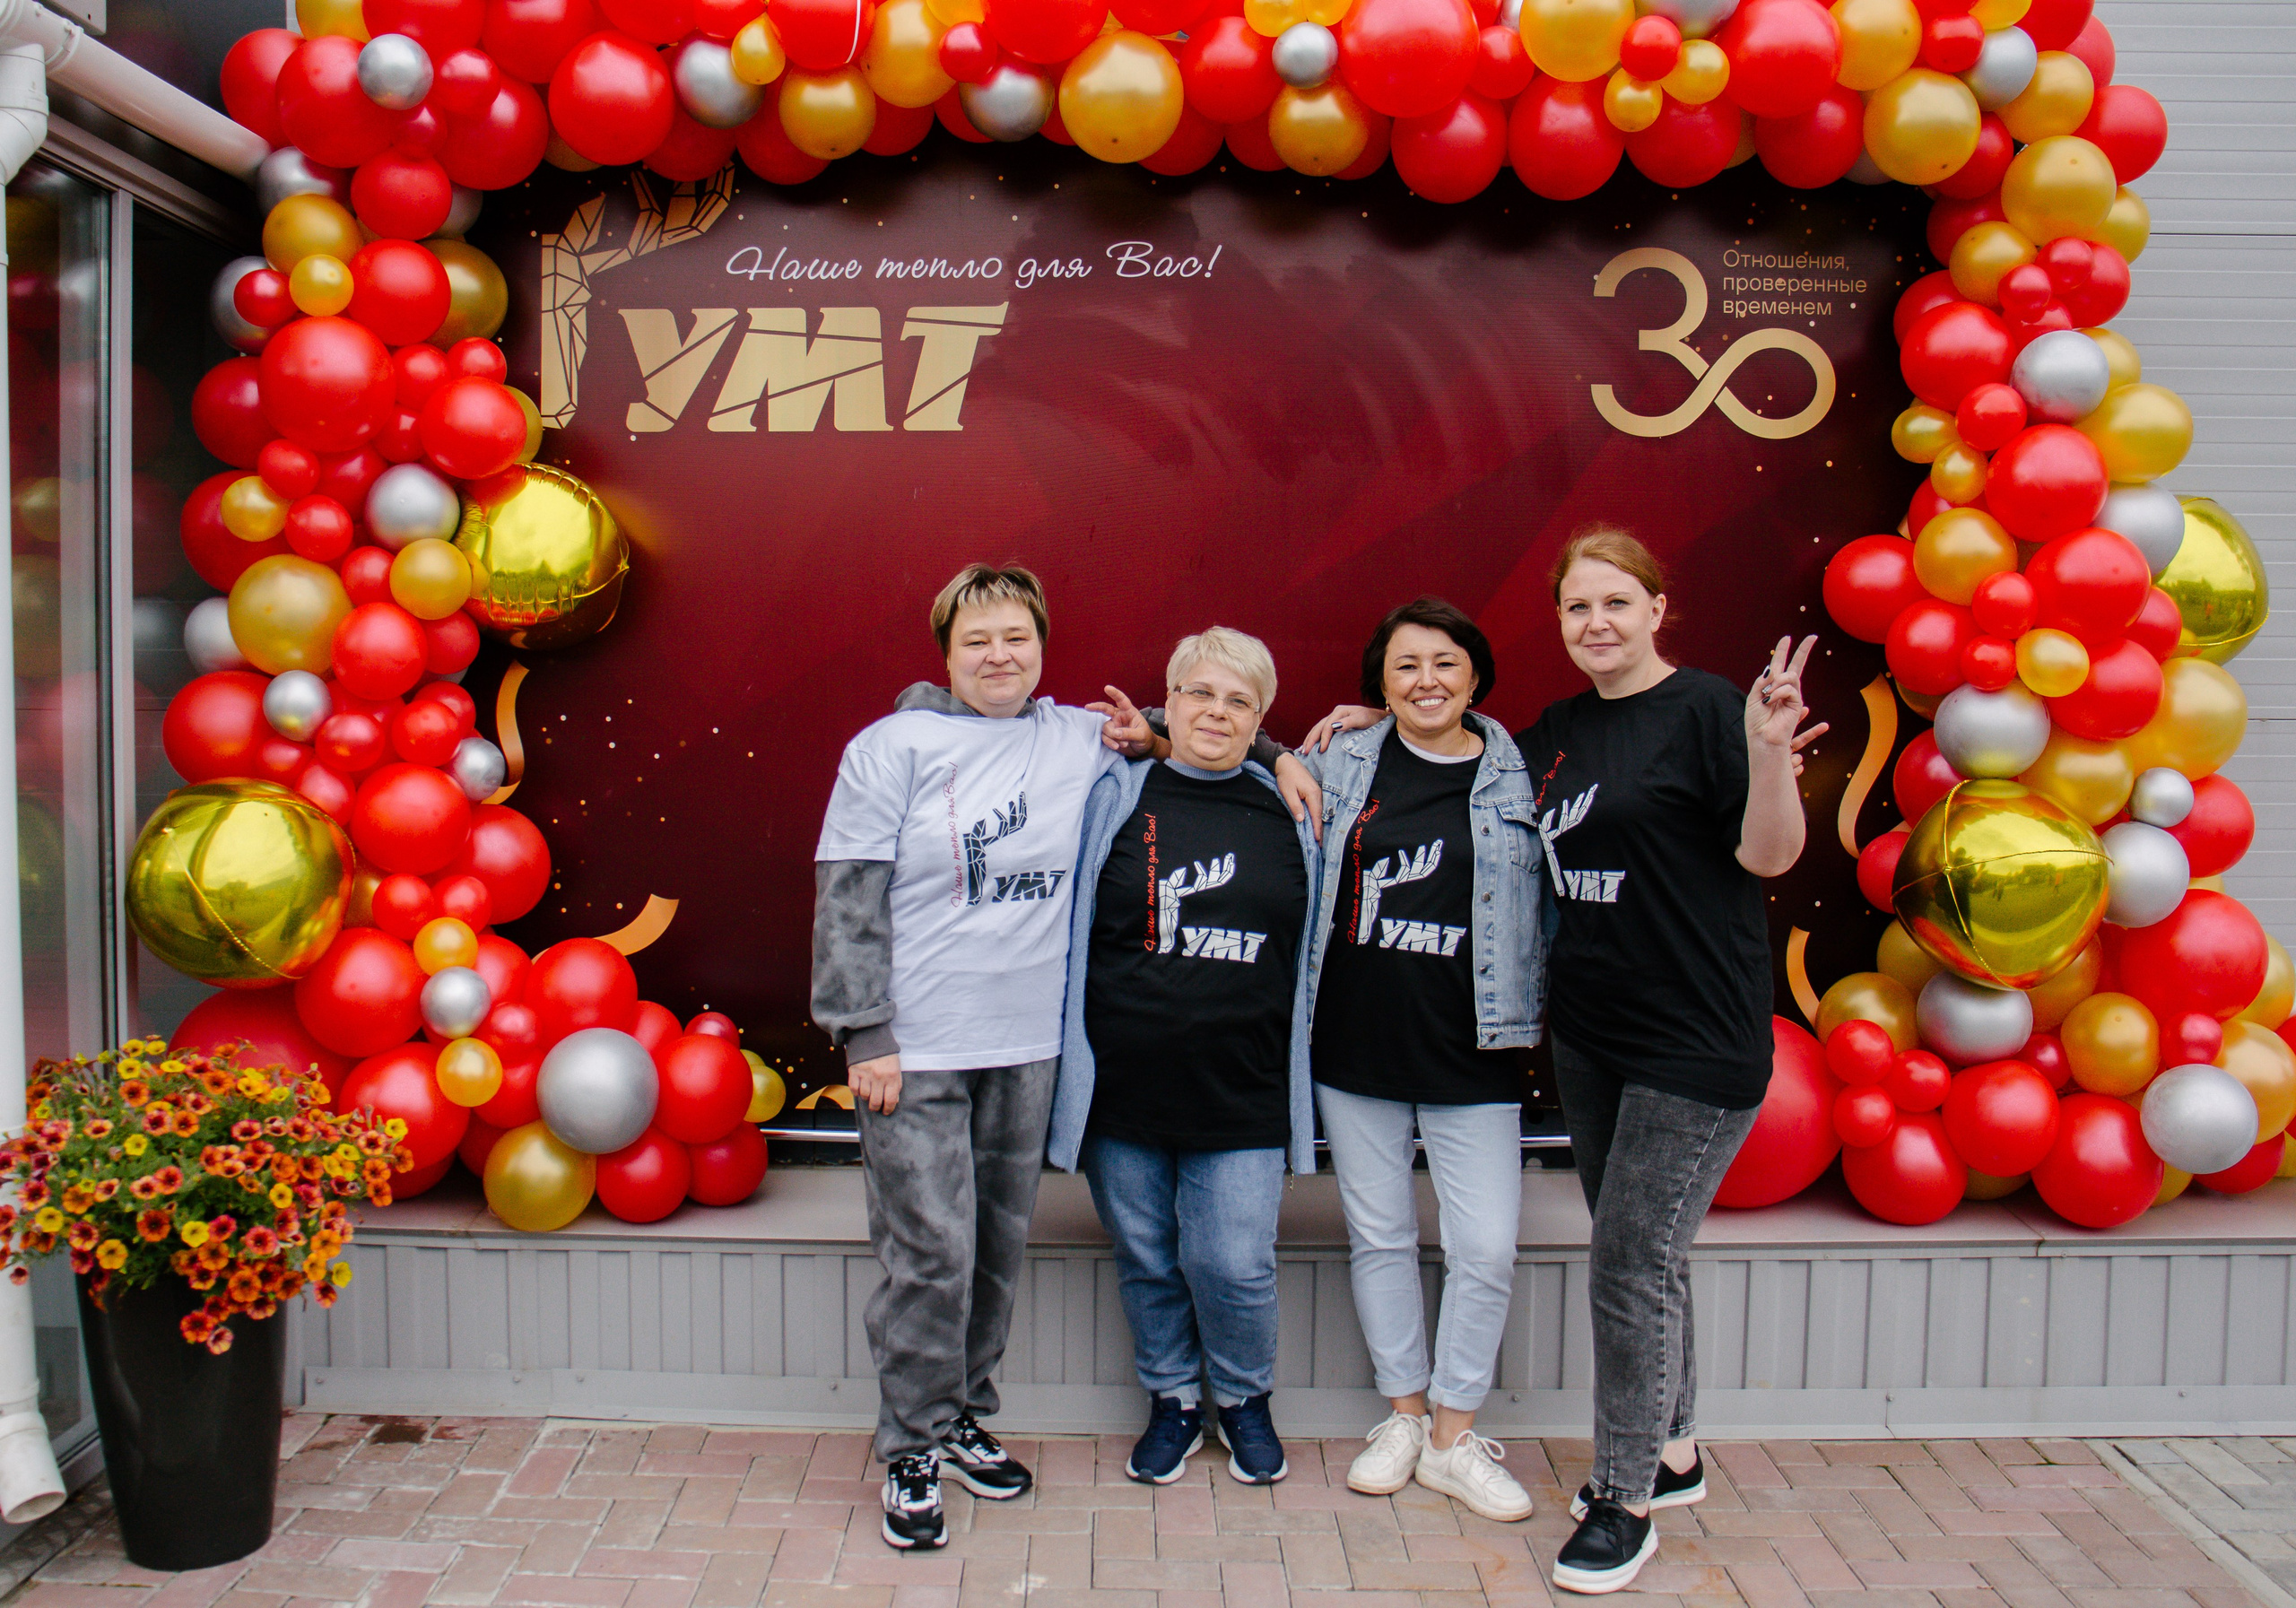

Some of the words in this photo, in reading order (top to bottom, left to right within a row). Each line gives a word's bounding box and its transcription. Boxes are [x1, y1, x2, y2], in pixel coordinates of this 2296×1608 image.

[726, 247, 862, 281] Наше
[876, 255, 1003, 281] тепло
[1015, 256, 1091, 289] для
[1106, 241, 1223, 279] Вас!
[1723, 249, 1850, 271] Отношения,
[1723, 276, 1867, 296] проверенные
[1723, 300, 1832, 317] временем
[944, 761, 959, 798] Вас!
[948, 797, 959, 819] для
[948, 821, 961, 860] тепло
[1144, 813, 1156, 844] Вас!
[1149, 845, 1159, 864] для
[950, 865, 963, 908] Наше
[1144, 909, 1156, 952] Наше
